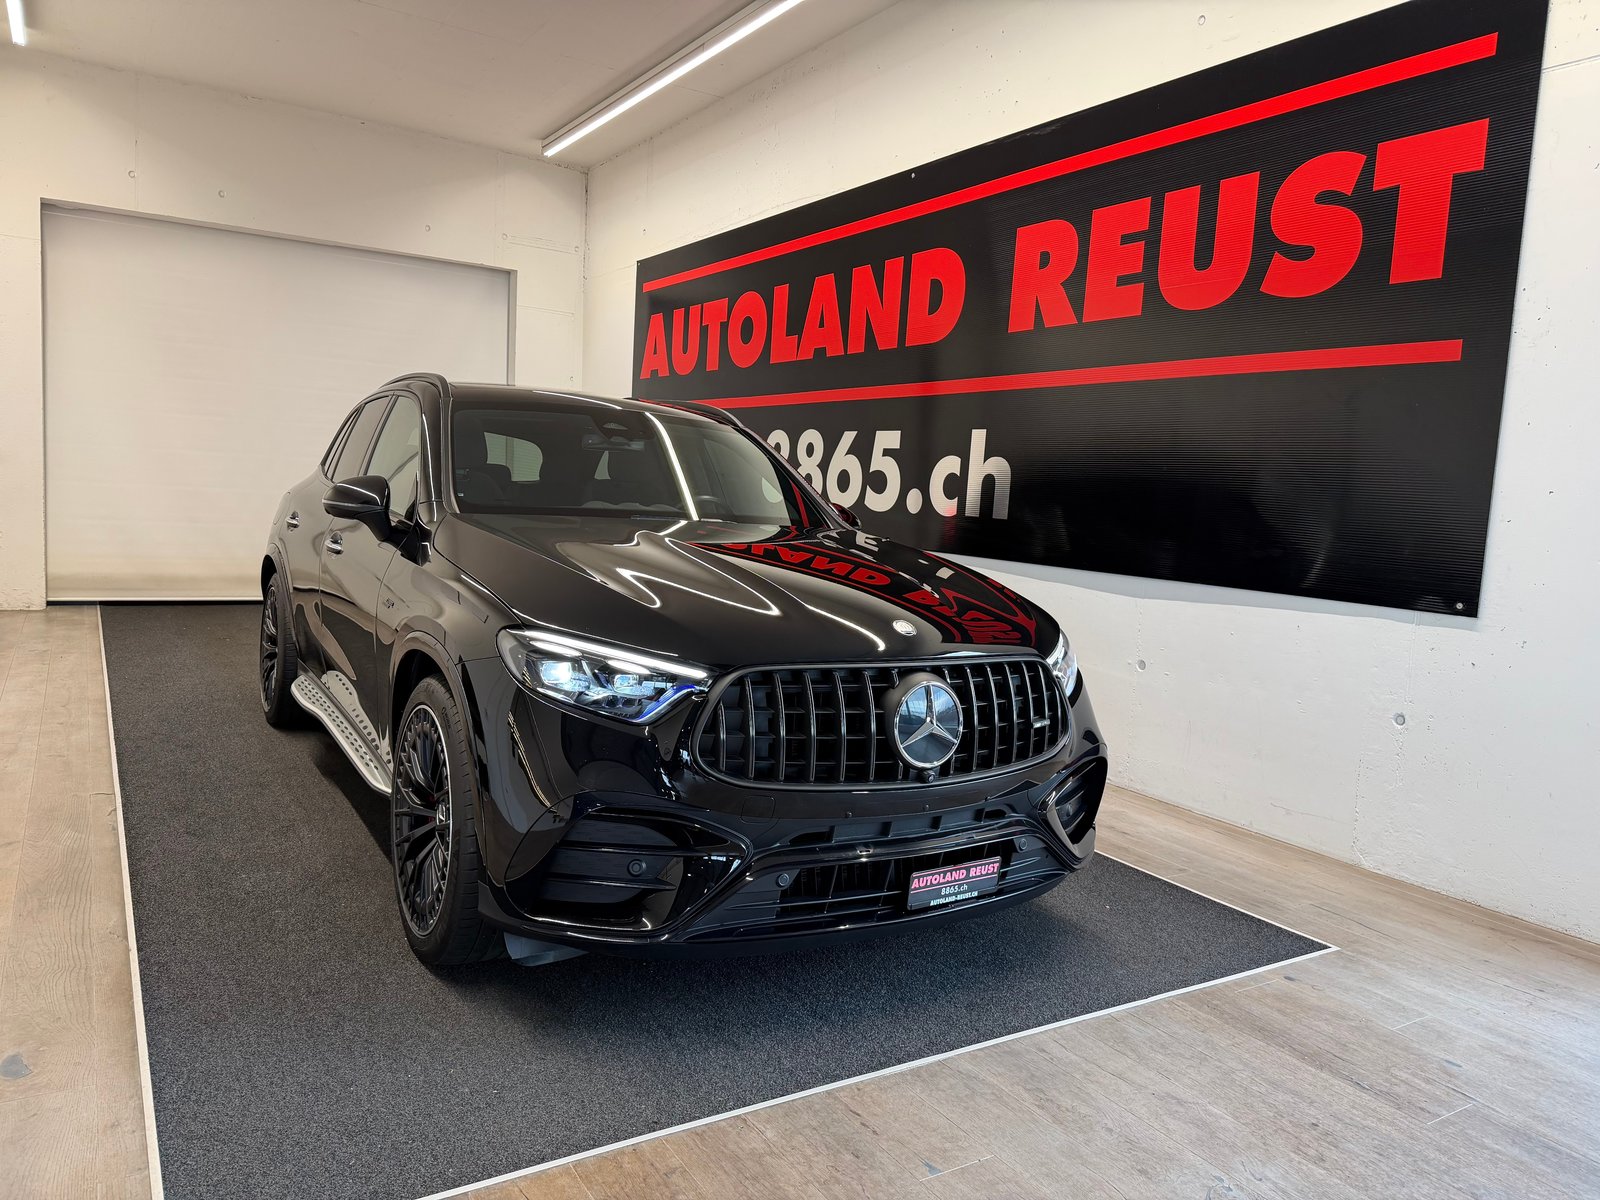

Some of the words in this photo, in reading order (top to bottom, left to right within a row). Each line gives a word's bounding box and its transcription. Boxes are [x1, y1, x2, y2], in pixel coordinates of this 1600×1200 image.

[639, 248, 966, 380] AUTOLAND
[1008, 118, 1490, 333] REUST
[911, 869, 967, 889] AUTOLAND
[969, 863, 1000, 877] REUST
[929, 891, 978, 906] AUTOLAND-REUST.CH
[940, 884, 968, 895] 8865.ch
